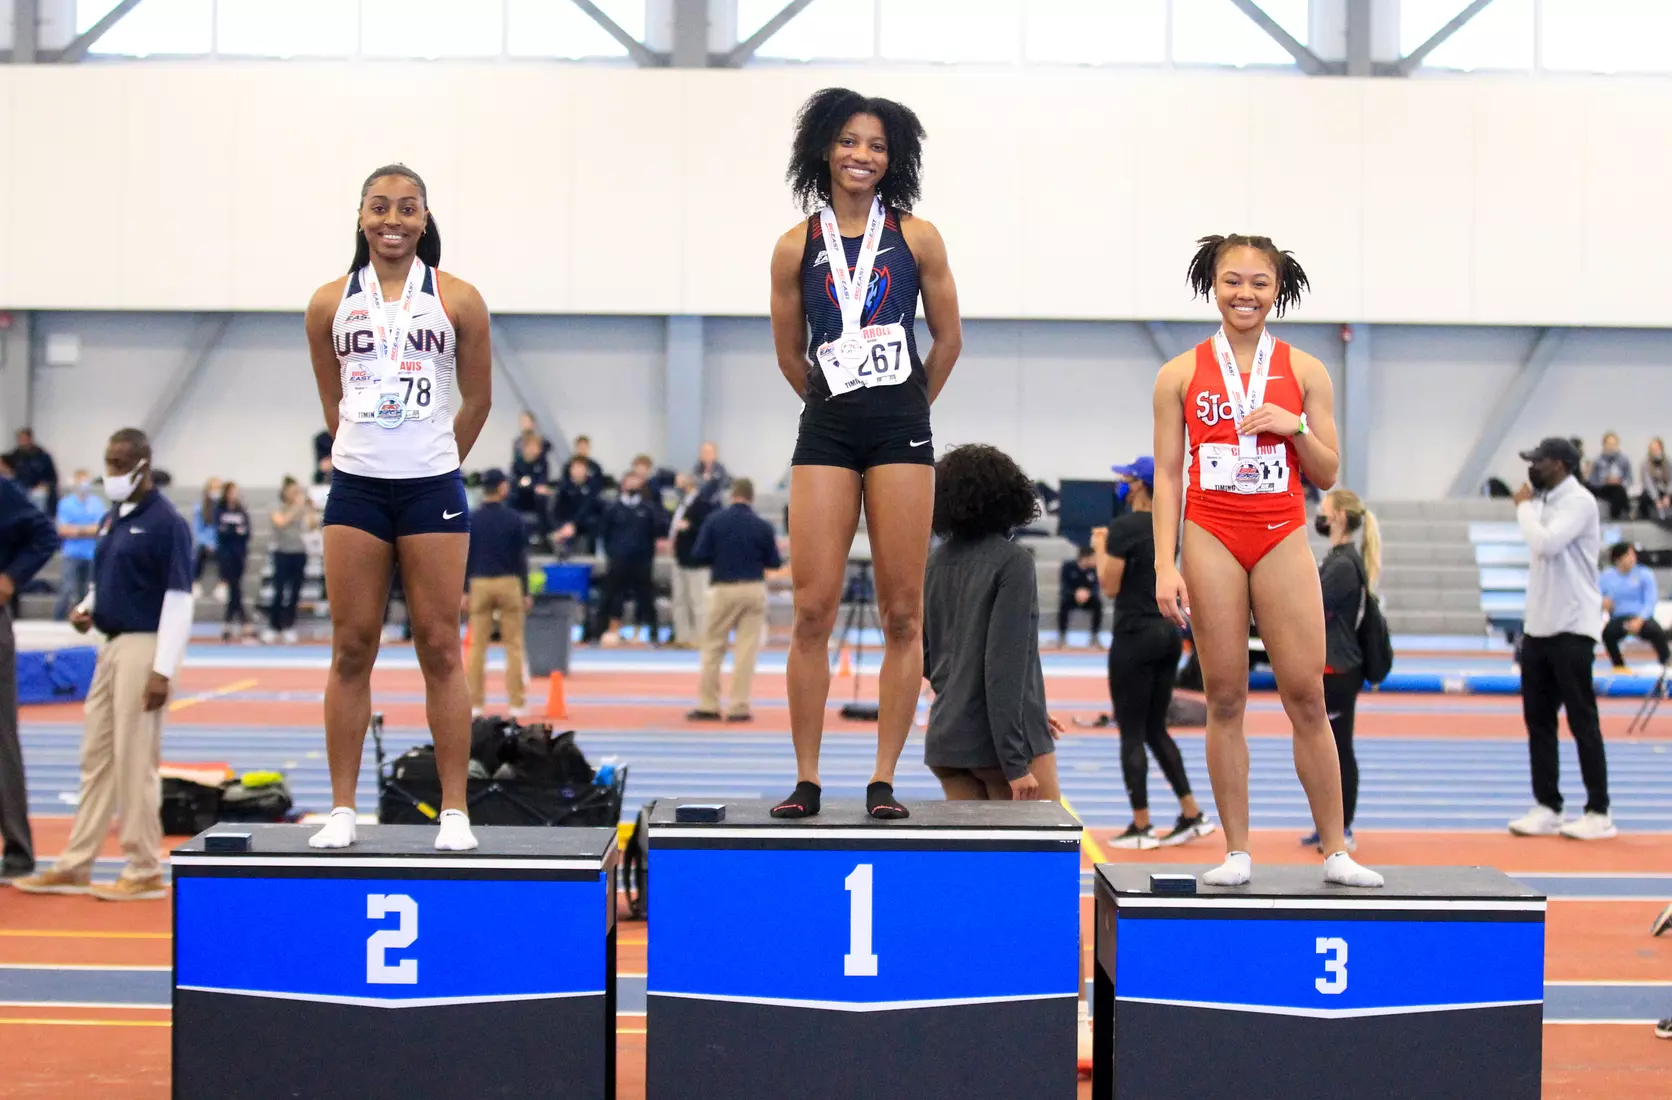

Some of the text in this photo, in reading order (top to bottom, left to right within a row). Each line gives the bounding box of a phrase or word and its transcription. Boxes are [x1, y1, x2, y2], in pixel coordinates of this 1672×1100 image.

[335, 328, 446, 357] UCNN
[862, 327, 892, 340] RROLL
[400, 361, 422, 371] AVIS
[858, 340, 902, 377] 267
[843, 863, 878, 976] 1
[366, 893, 419, 985] 2
[1314, 936, 1348, 995] 3
